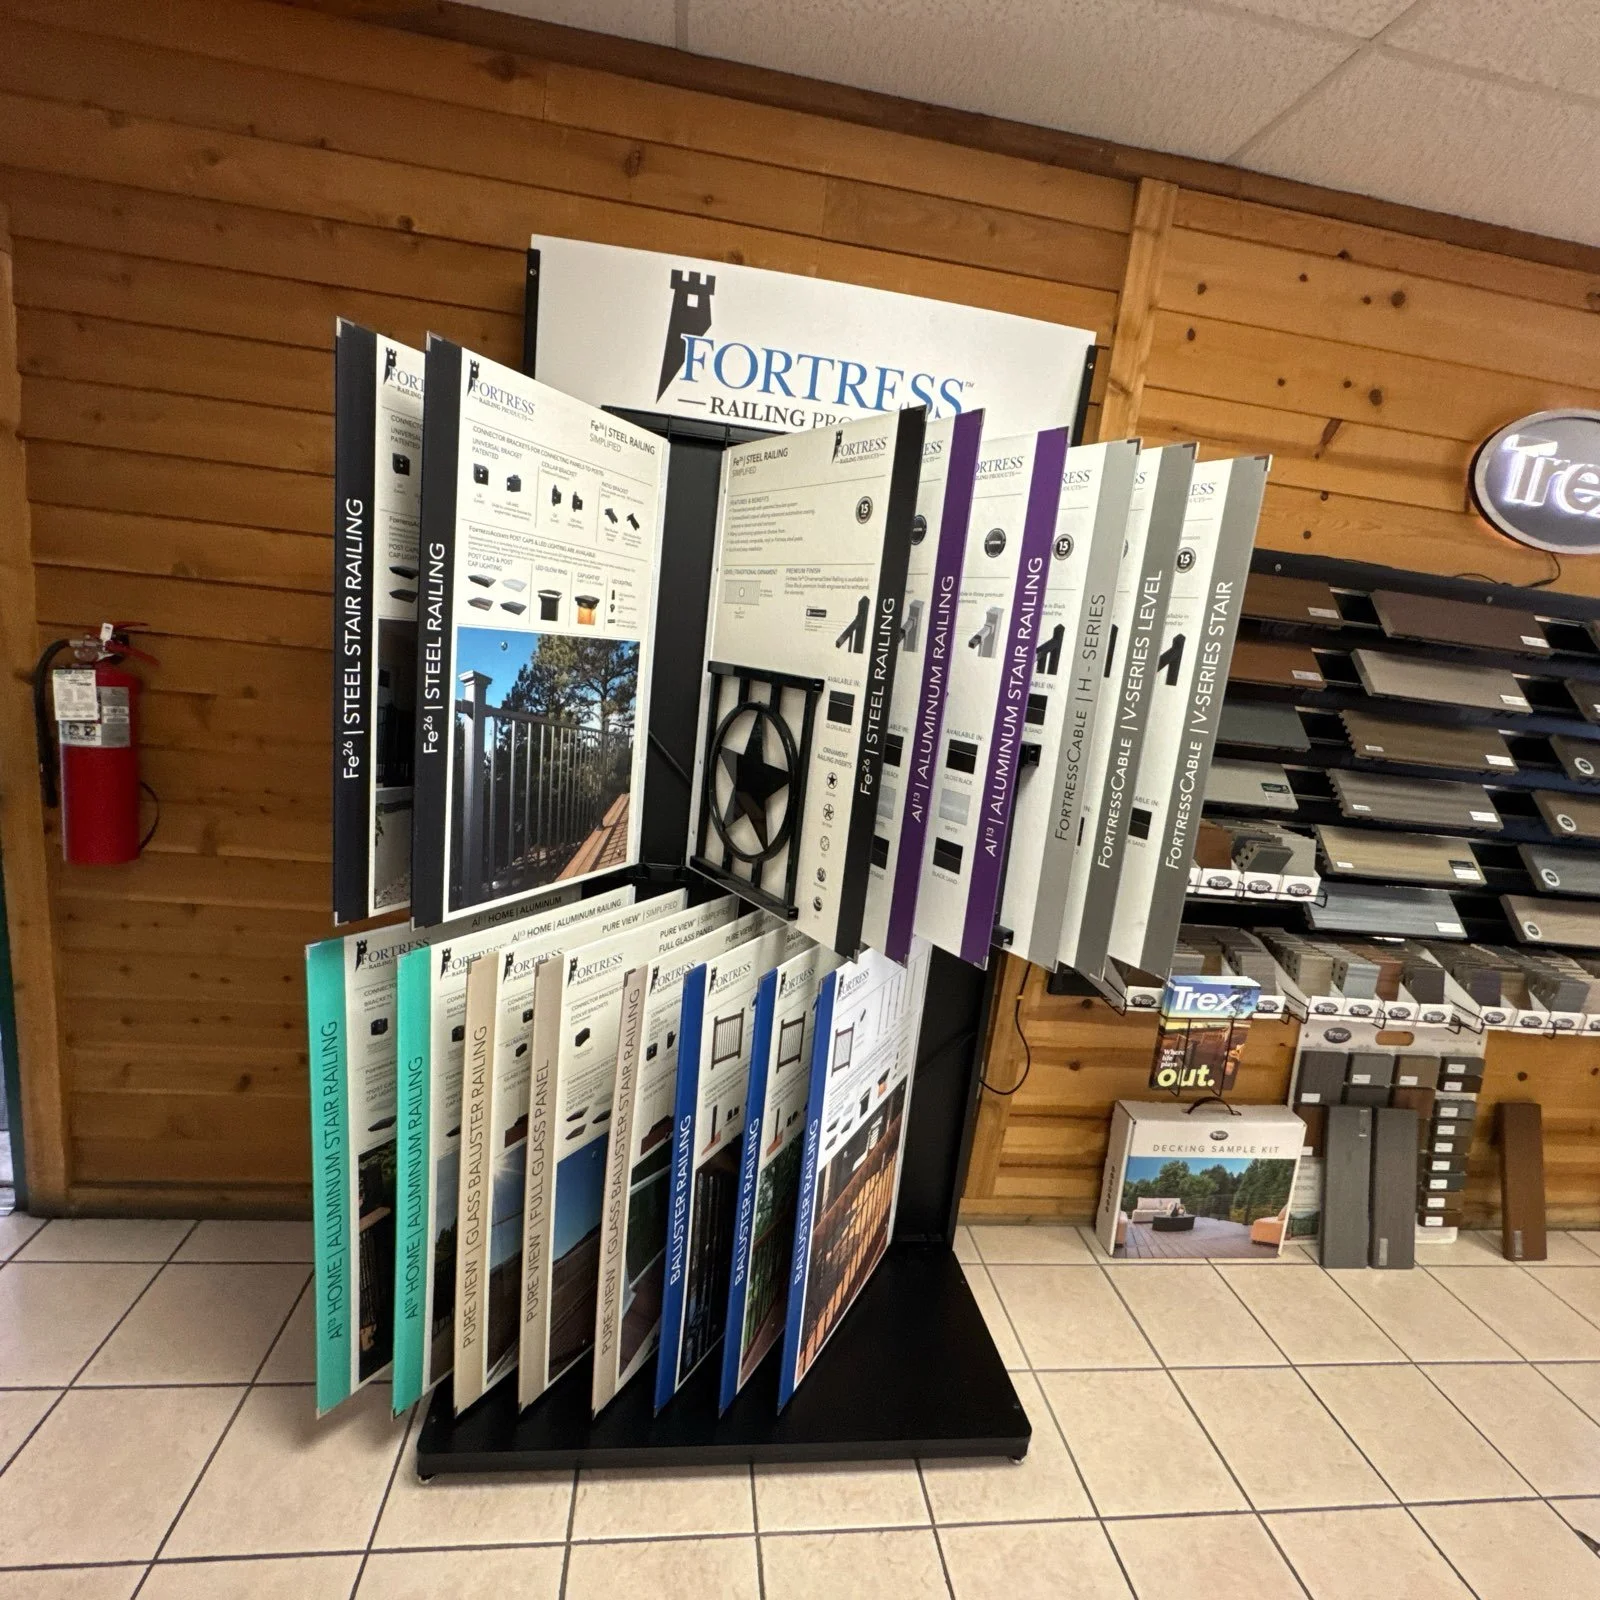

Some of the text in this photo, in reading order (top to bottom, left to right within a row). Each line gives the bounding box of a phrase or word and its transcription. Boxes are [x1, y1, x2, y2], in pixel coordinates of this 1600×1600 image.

[472, 376, 535, 416] FORTRESS
[710, 396, 804, 427] RAILING
[472, 438, 522, 460] UNIVERSAL BRACKET
[472, 446, 499, 460] PATENTED
[473, 426, 506, 442] CONNECTOR
[590, 433, 622, 453] SIMPLIFIED
[608, 428, 655, 455] STEEL RAILING
[835, 437, 888, 458] FORTRESS
[746, 448, 788, 464] STEEL RAILING
[1502, 434, 1600, 518] Tre
[860, 503, 870, 514] 15
[346, 498, 363, 590] RAILING
[468, 552, 482, 560] POST
[482, 554, 495, 562] CAPS
[501, 558, 513, 566] POST
[510, 534, 522, 544] POST
[522, 536, 534, 545] CAPS
[1060, 542, 1068, 552] 15
[1180, 554, 1190, 564] 15
[427, 542, 445, 630] RAILING
[480, 562, 502, 572] LIGHTING
[1017, 557, 1042, 640] RAILING
[344, 597, 362, 656] STAIR
[1083, 594, 1106, 660] SERIES
[1123, 636, 1150, 723] V-SERIES
[1140, 570, 1162, 630] LEVEL
[1192, 640, 1221, 726] V-SERIES
[1208, 581, 1234, 638] STAIR
[425, 638, 442, 698] STEEL
[828, 676, 852, 686] AVAILABLE
[918, 664, 943, 780] ALUMINUM
[932, 575, 954, 662] RAILING
[1008, 645, 1028, 700] STAIR
[1078, 678, 1092, 691] H
[344, 668, 361, 724] STEEL
[860, 598, 895, 795] Fe26 STEEL RAILING
[946, 728, 976, 740] AVAILABLE
[990, 704, 1018, 816] ALUMINUM
[488, 896, 562, 924] HOME ALUMINUM
[526, 899, 622, 938] HOME ALUMINUM RAILING
[602, 920, 621, 934] PURE
[646, 900, 678, 920] SIMPLIFIED
[658, 925, 714, 952] FULL GLASS PANEL
[660, 925, 677, 938] PURE
[725, 931, 740, 944] PURE
[571, 952, 624, 981] FORTRESS
[1173, 986, 1241, 1012] Trex
[1328, 1030, 1349, 1040] Trex
[322, 1021, 338, 1096] RAILING
[1158, 1064, 1215, 1087] out.
[408, 1056, 423, 1128] RAILING
[324, 1098, 340, 1146] STAIR
[1152, 1144, 1280, 1154] DECKING SAMPLE KIT
[406, 1137, 422, 1228] ALUMINUM
[464, 1026, 487, 1348] PURE VIEW GLASS BALUSTER RAILING
[526, 1059, 550, 1323] PURE VIEW FULL GLASS PANEL
[602, 988, 640, 1356] PURE VIEW GLASS BALUSTER STAIR RAILING
[326, 1151, 342, 1248] ALUMINUM
[670, 1114, 692, 1286] BALUSTER RAILING
[735, 1117, 760, 1286] BALUSTER RAILING
[794, 1118, 818, 1284] BALUSTER RAILING
[326, 1255, 342, 1317] HOME
[405, 1239, 421, 1298] HOME
